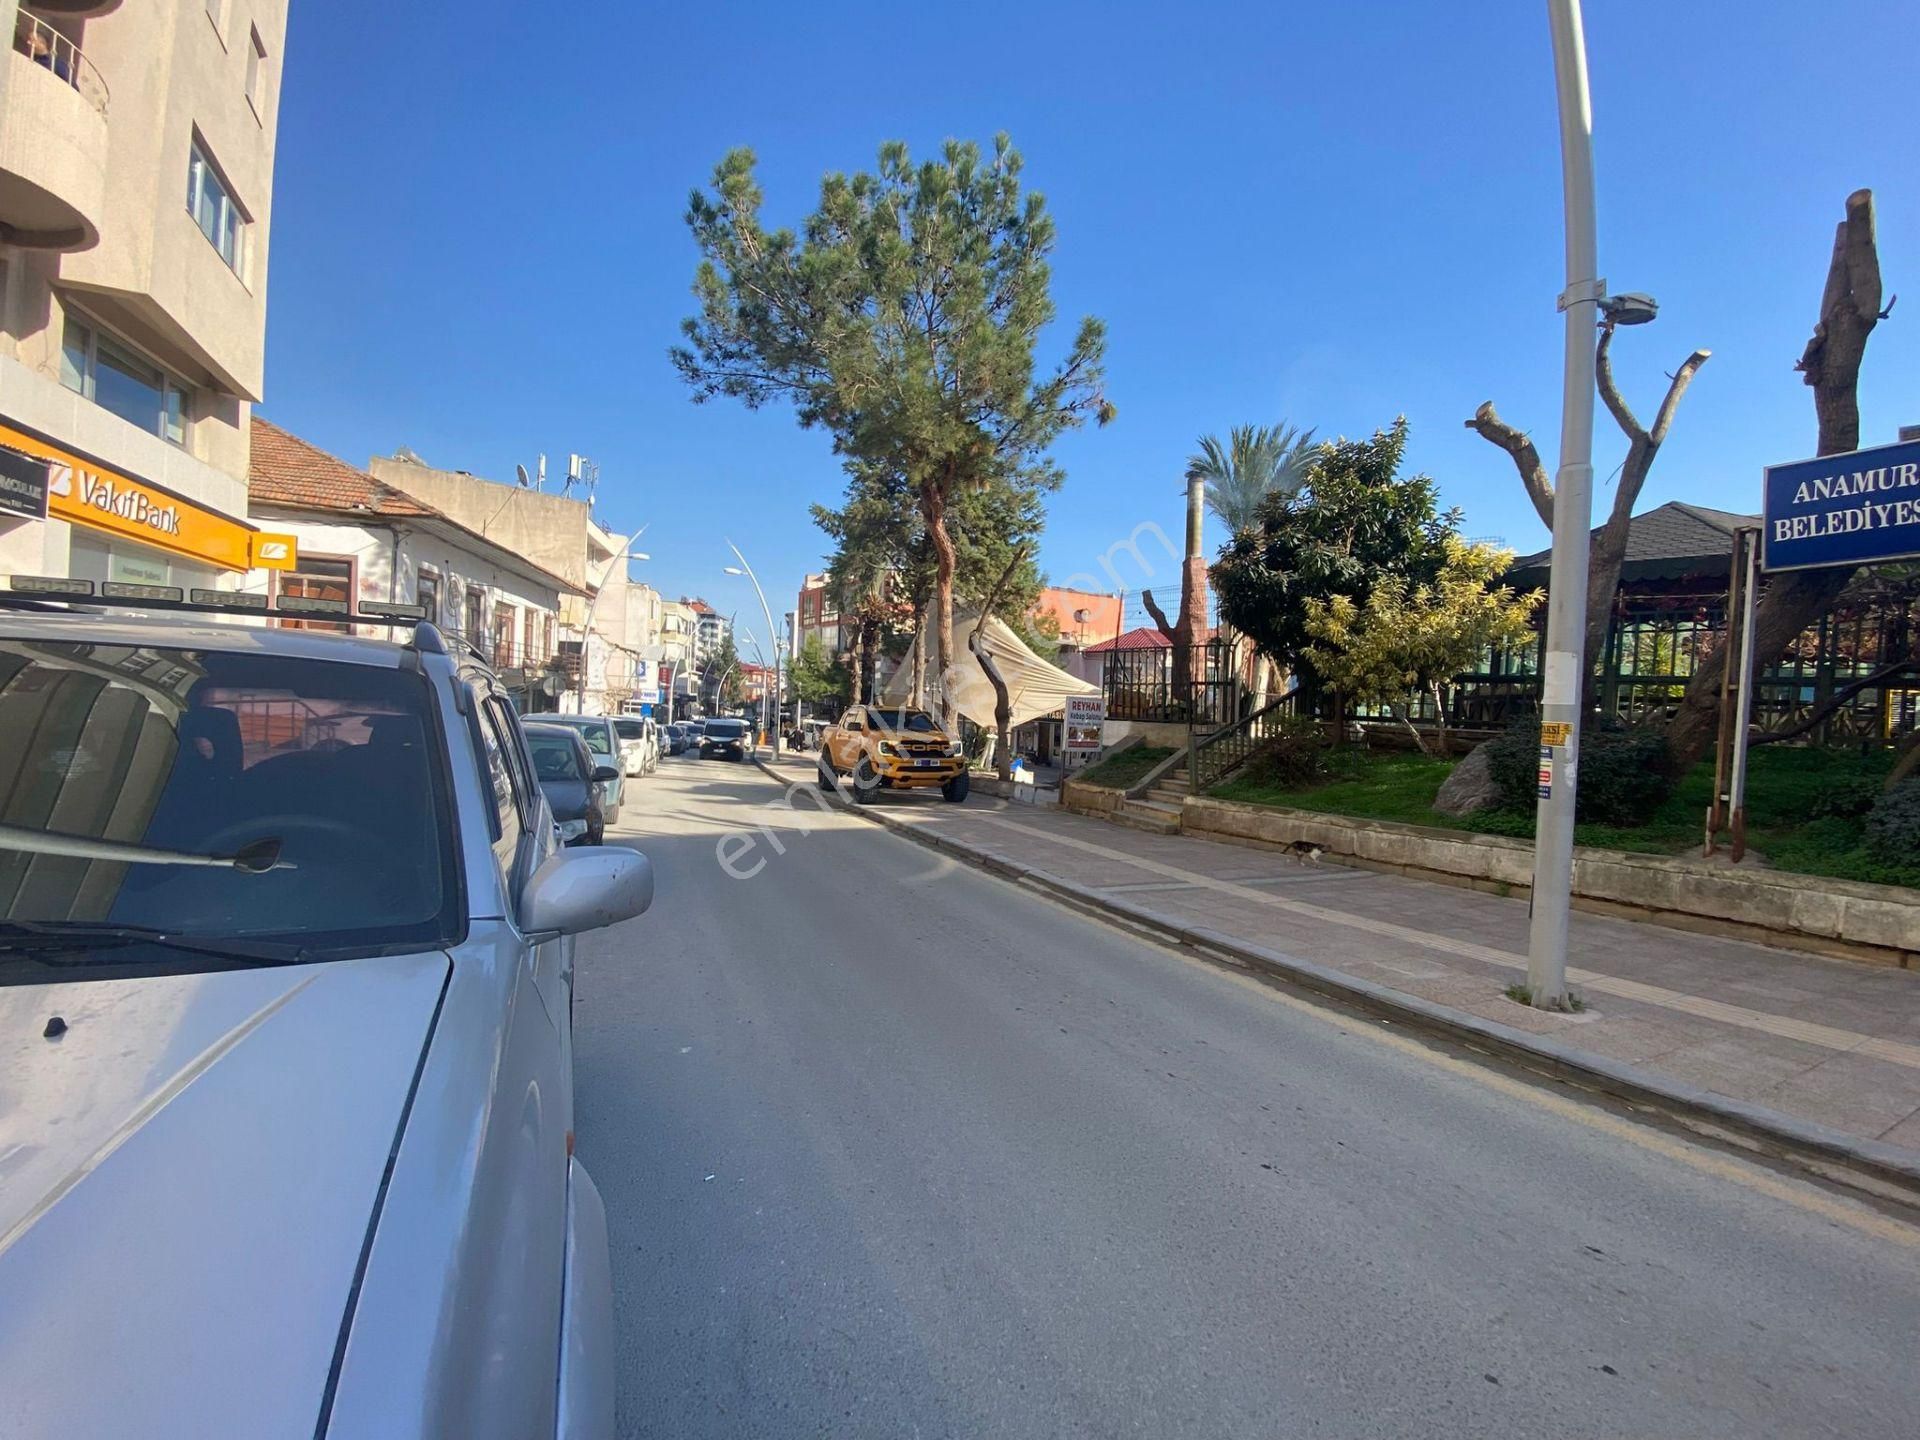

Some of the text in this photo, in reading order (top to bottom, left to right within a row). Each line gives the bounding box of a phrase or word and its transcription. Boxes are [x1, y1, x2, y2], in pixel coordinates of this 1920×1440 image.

[79, 469, 182, 537] VakıfBank
[1792, 463, 1920, 504] ANAMUR
[1072, 701, 1101, 712] REYHAN
